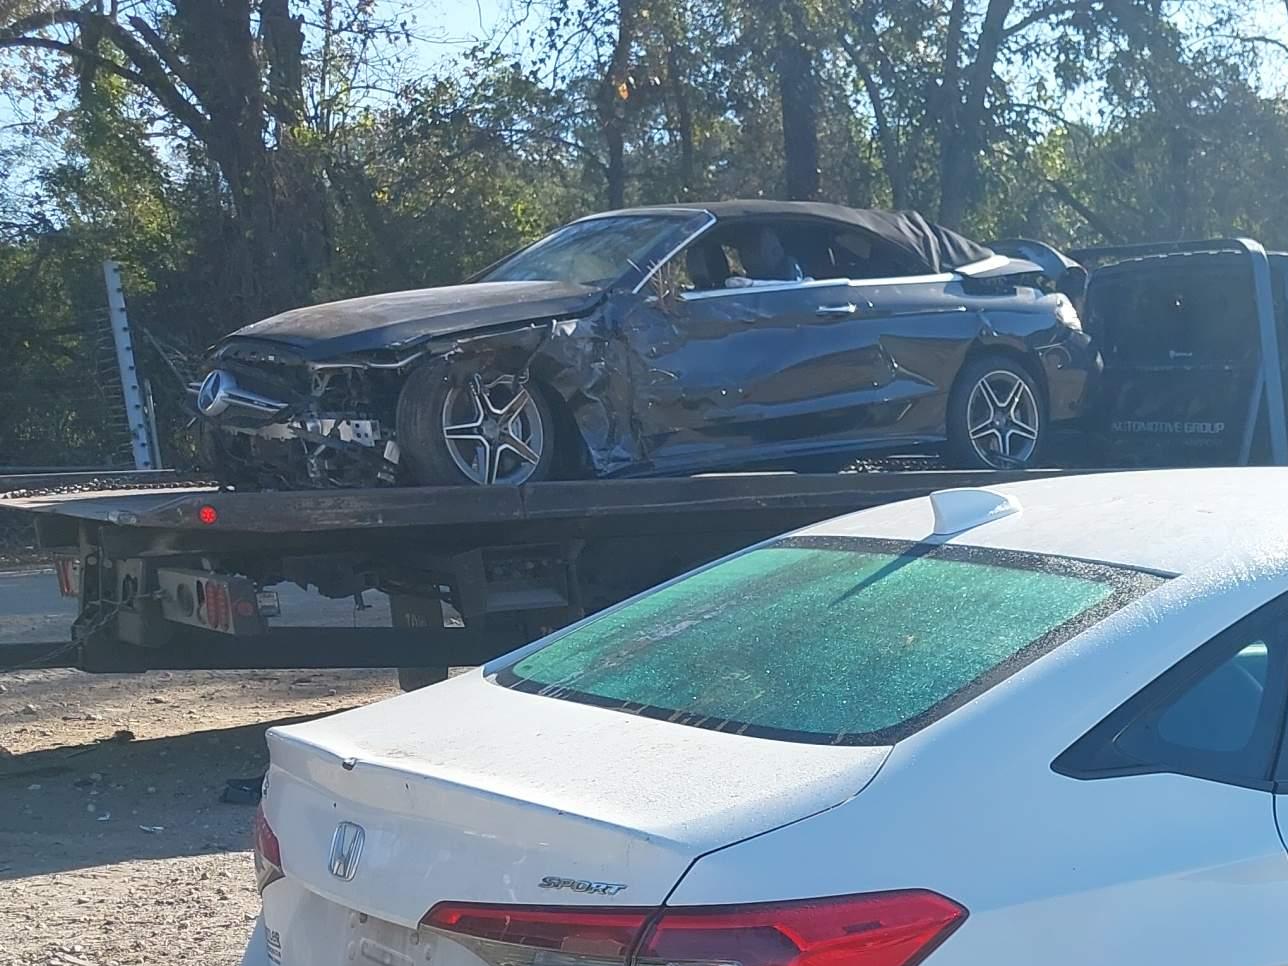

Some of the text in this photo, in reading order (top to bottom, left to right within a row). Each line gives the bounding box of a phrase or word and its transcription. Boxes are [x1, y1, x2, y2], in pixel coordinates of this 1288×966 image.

[1111, 421, 1224, 433] AUTOMOTIVE GROUP
[538, 876, 628, 895] SPORT
